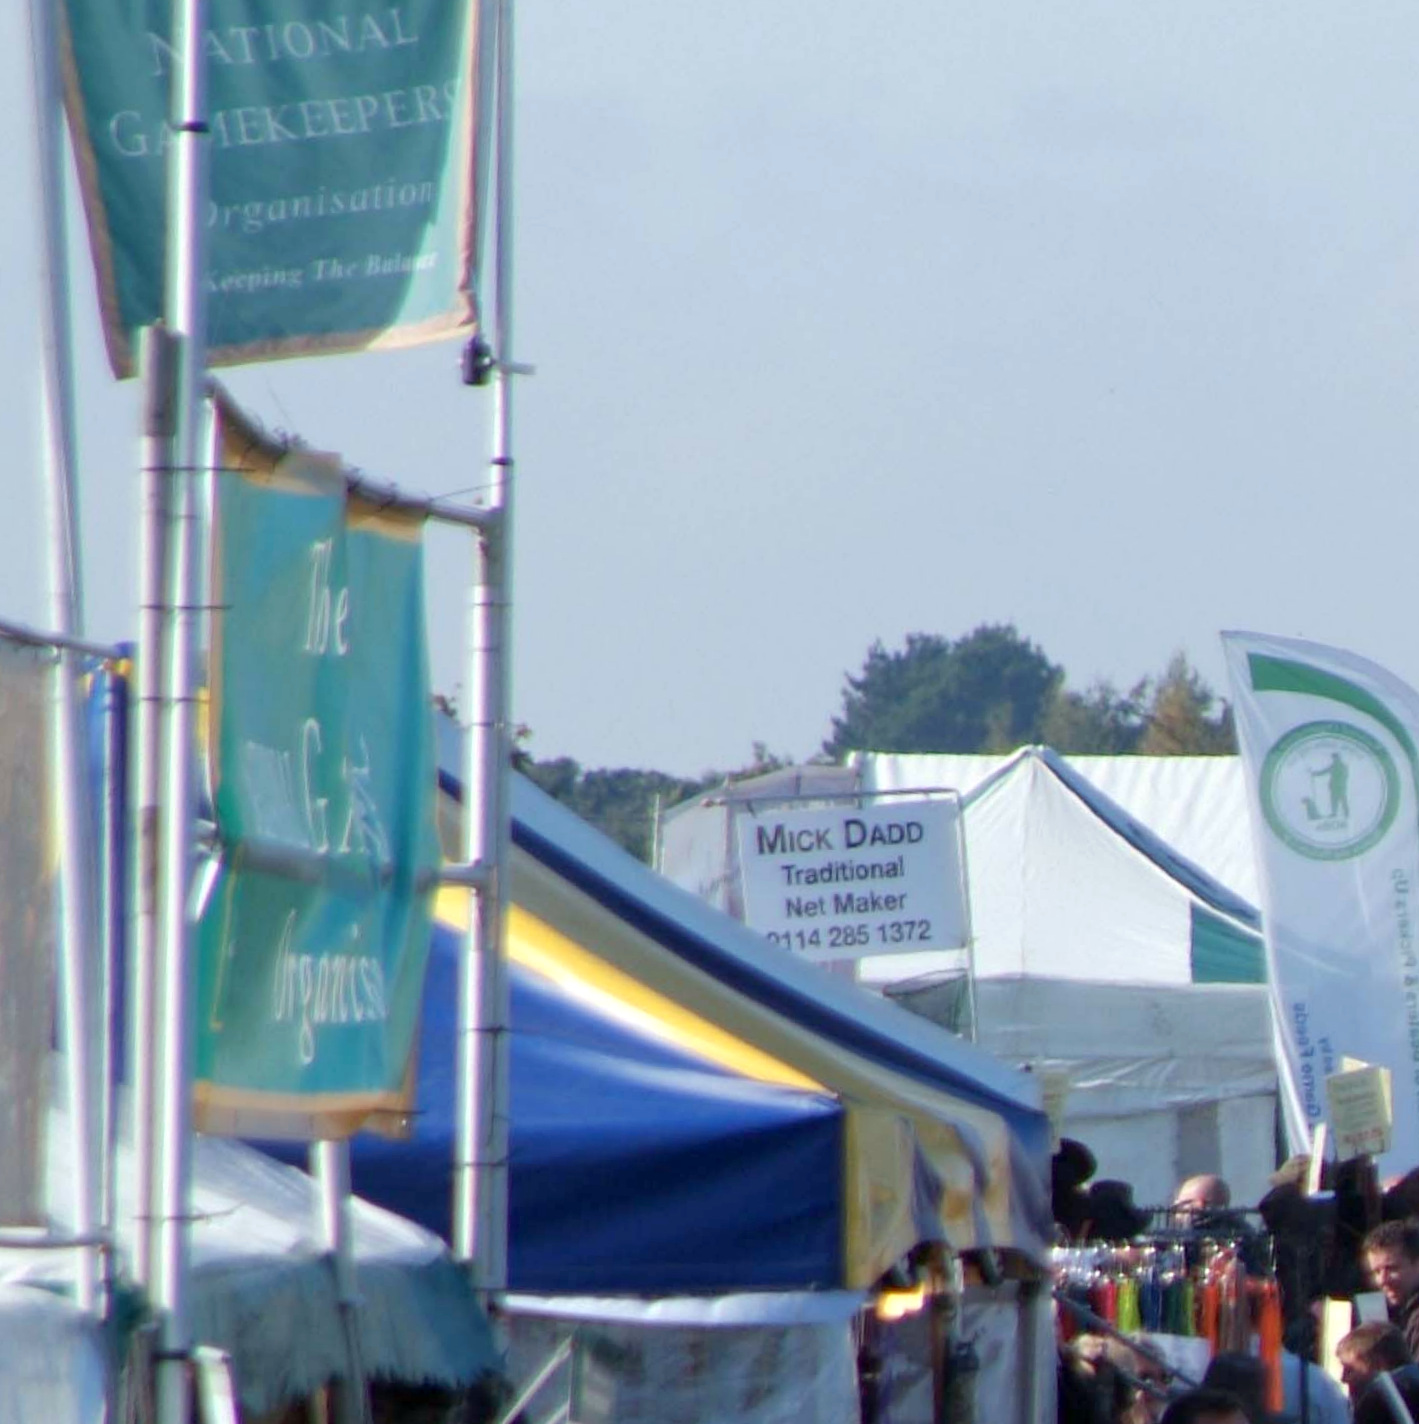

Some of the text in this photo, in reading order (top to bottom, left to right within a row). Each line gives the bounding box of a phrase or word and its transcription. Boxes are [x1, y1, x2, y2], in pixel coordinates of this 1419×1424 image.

[148, 9, 419, 77] NATIONAL
[315, 258, 360, 281] The
[304, 540, 349, 656] The
[756, 818, 924, 856] MICK DADD
[781, 855, 904, 886] Traditional
[786, 890, 907, 918] Net Maker
[829, 925, 870, 948] 285
[877, 919, 932, 943] 1372
